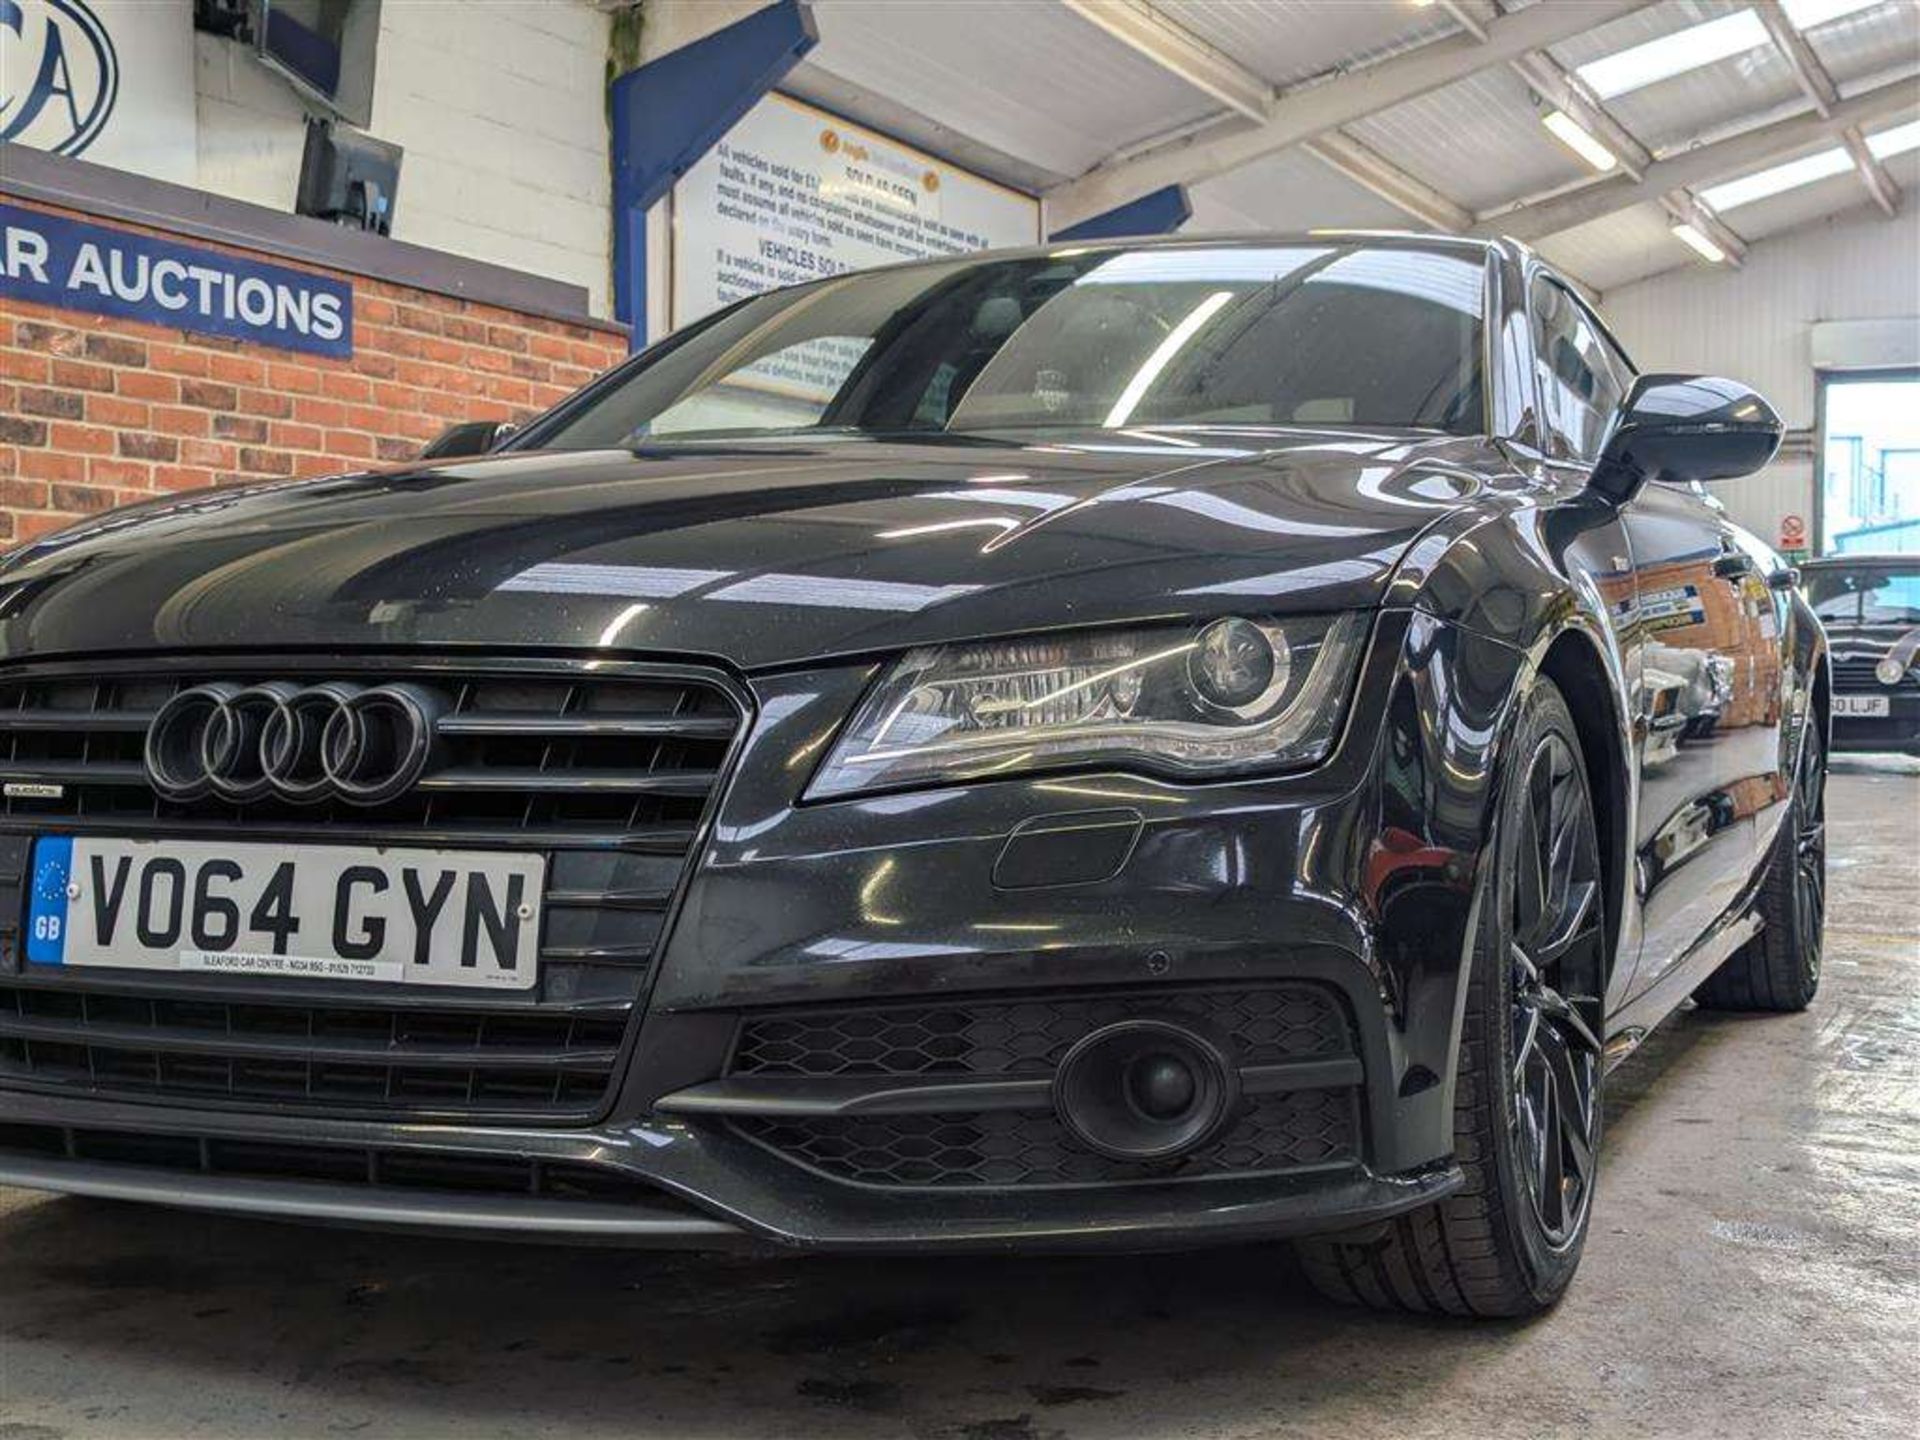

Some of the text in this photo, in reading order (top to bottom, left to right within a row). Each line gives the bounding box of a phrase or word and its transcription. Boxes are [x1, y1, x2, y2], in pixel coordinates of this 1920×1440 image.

[717, 142, 730, 159] All
[731, 149, 769, 174] vehicles
[770, 162, 790, 181] sold
[790, 167, 804, 185] for
[778, 184, 795, 201] and
[717, 201, 758, 225] declared
[758, 237, 816, 272] VEHICLES
[66, 242, 344, 341] AUCTIONS
[1850, 699, 1882, 713] LJF
[35, 915, 61, 942] GB
[331, 864, 525, 971] GYN
[240, 956, 255, 967] CAR
[257, 958, 284, 970] CENTRE
